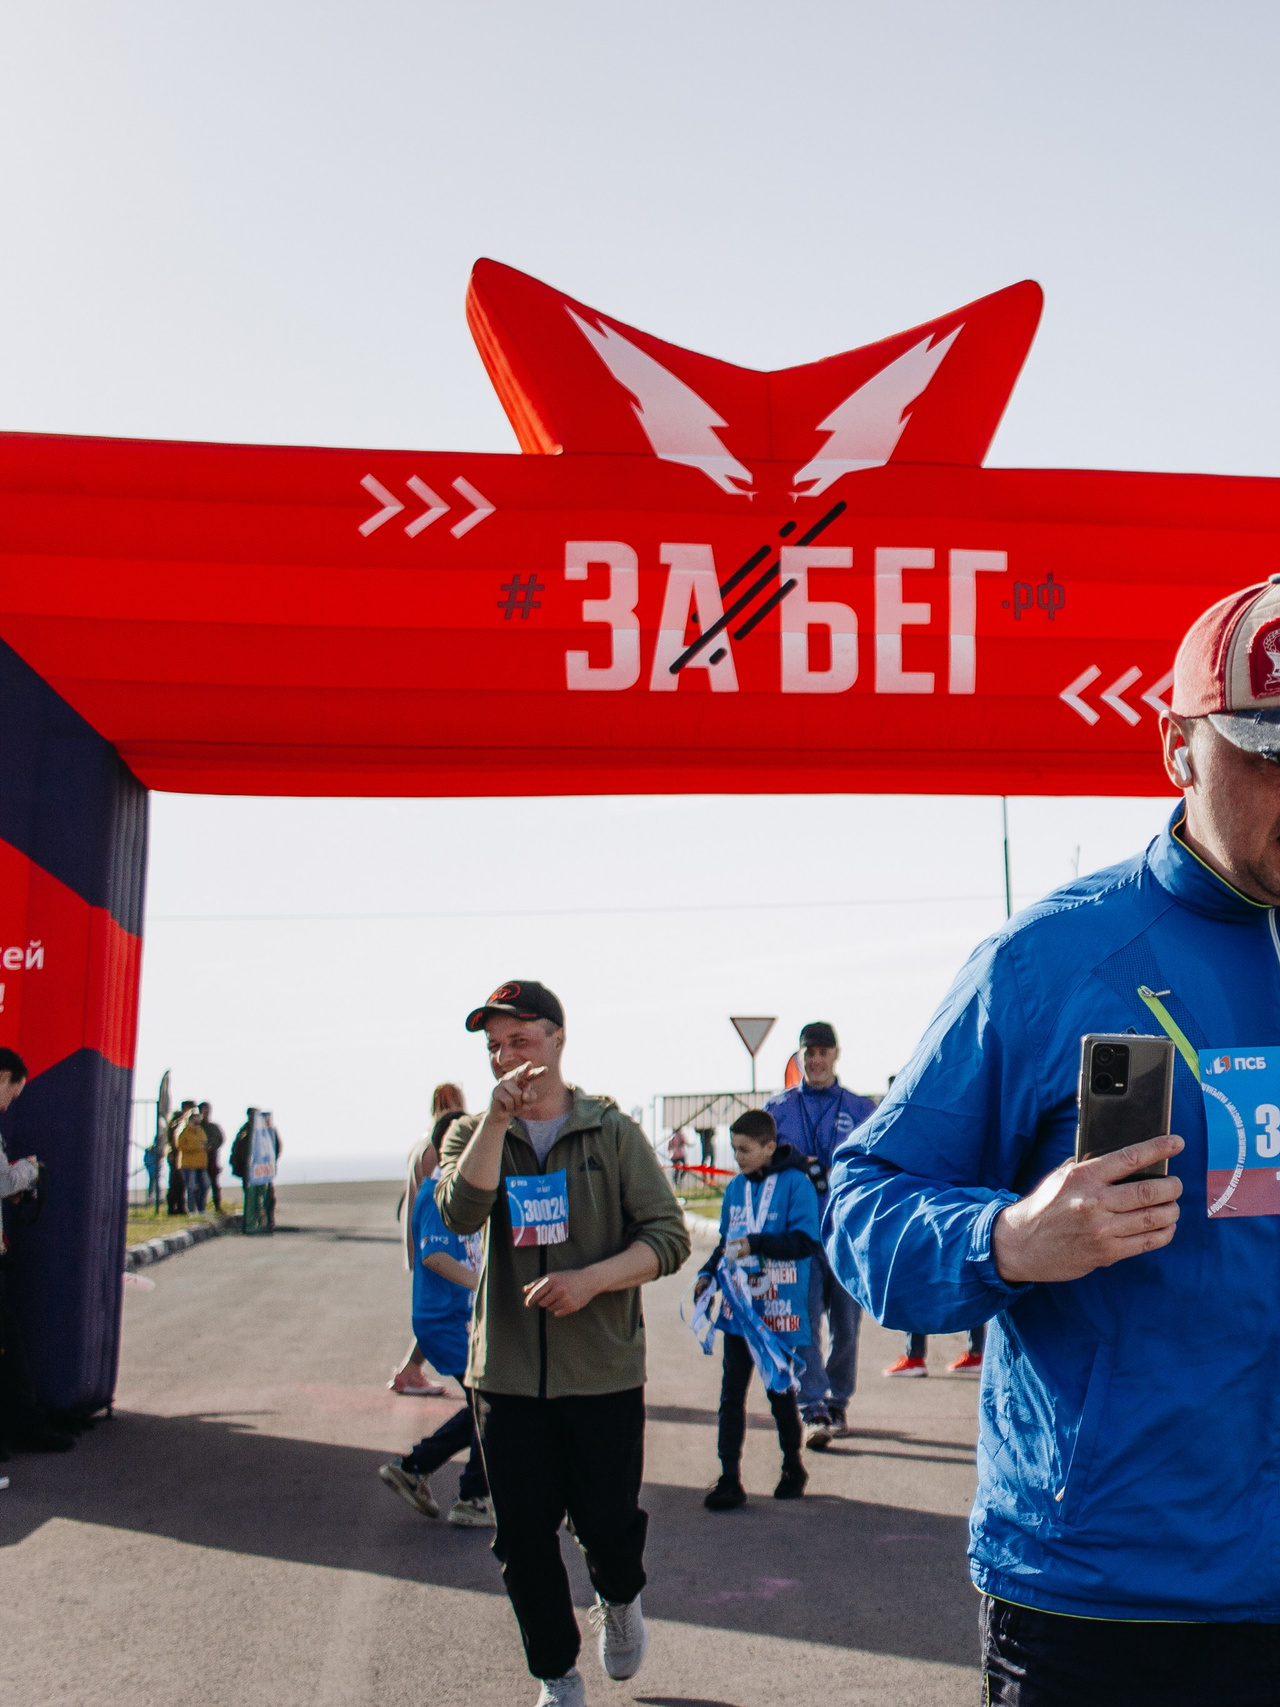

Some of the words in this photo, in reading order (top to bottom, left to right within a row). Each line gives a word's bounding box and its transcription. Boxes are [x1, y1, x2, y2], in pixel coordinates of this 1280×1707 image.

[0, 939, 44, 970] ей
[1234, 1057, 1266, 1070] ПСБ
[523, 1195, 566, 1222] 30024
[764, 1299, 792, 1316] 2024
